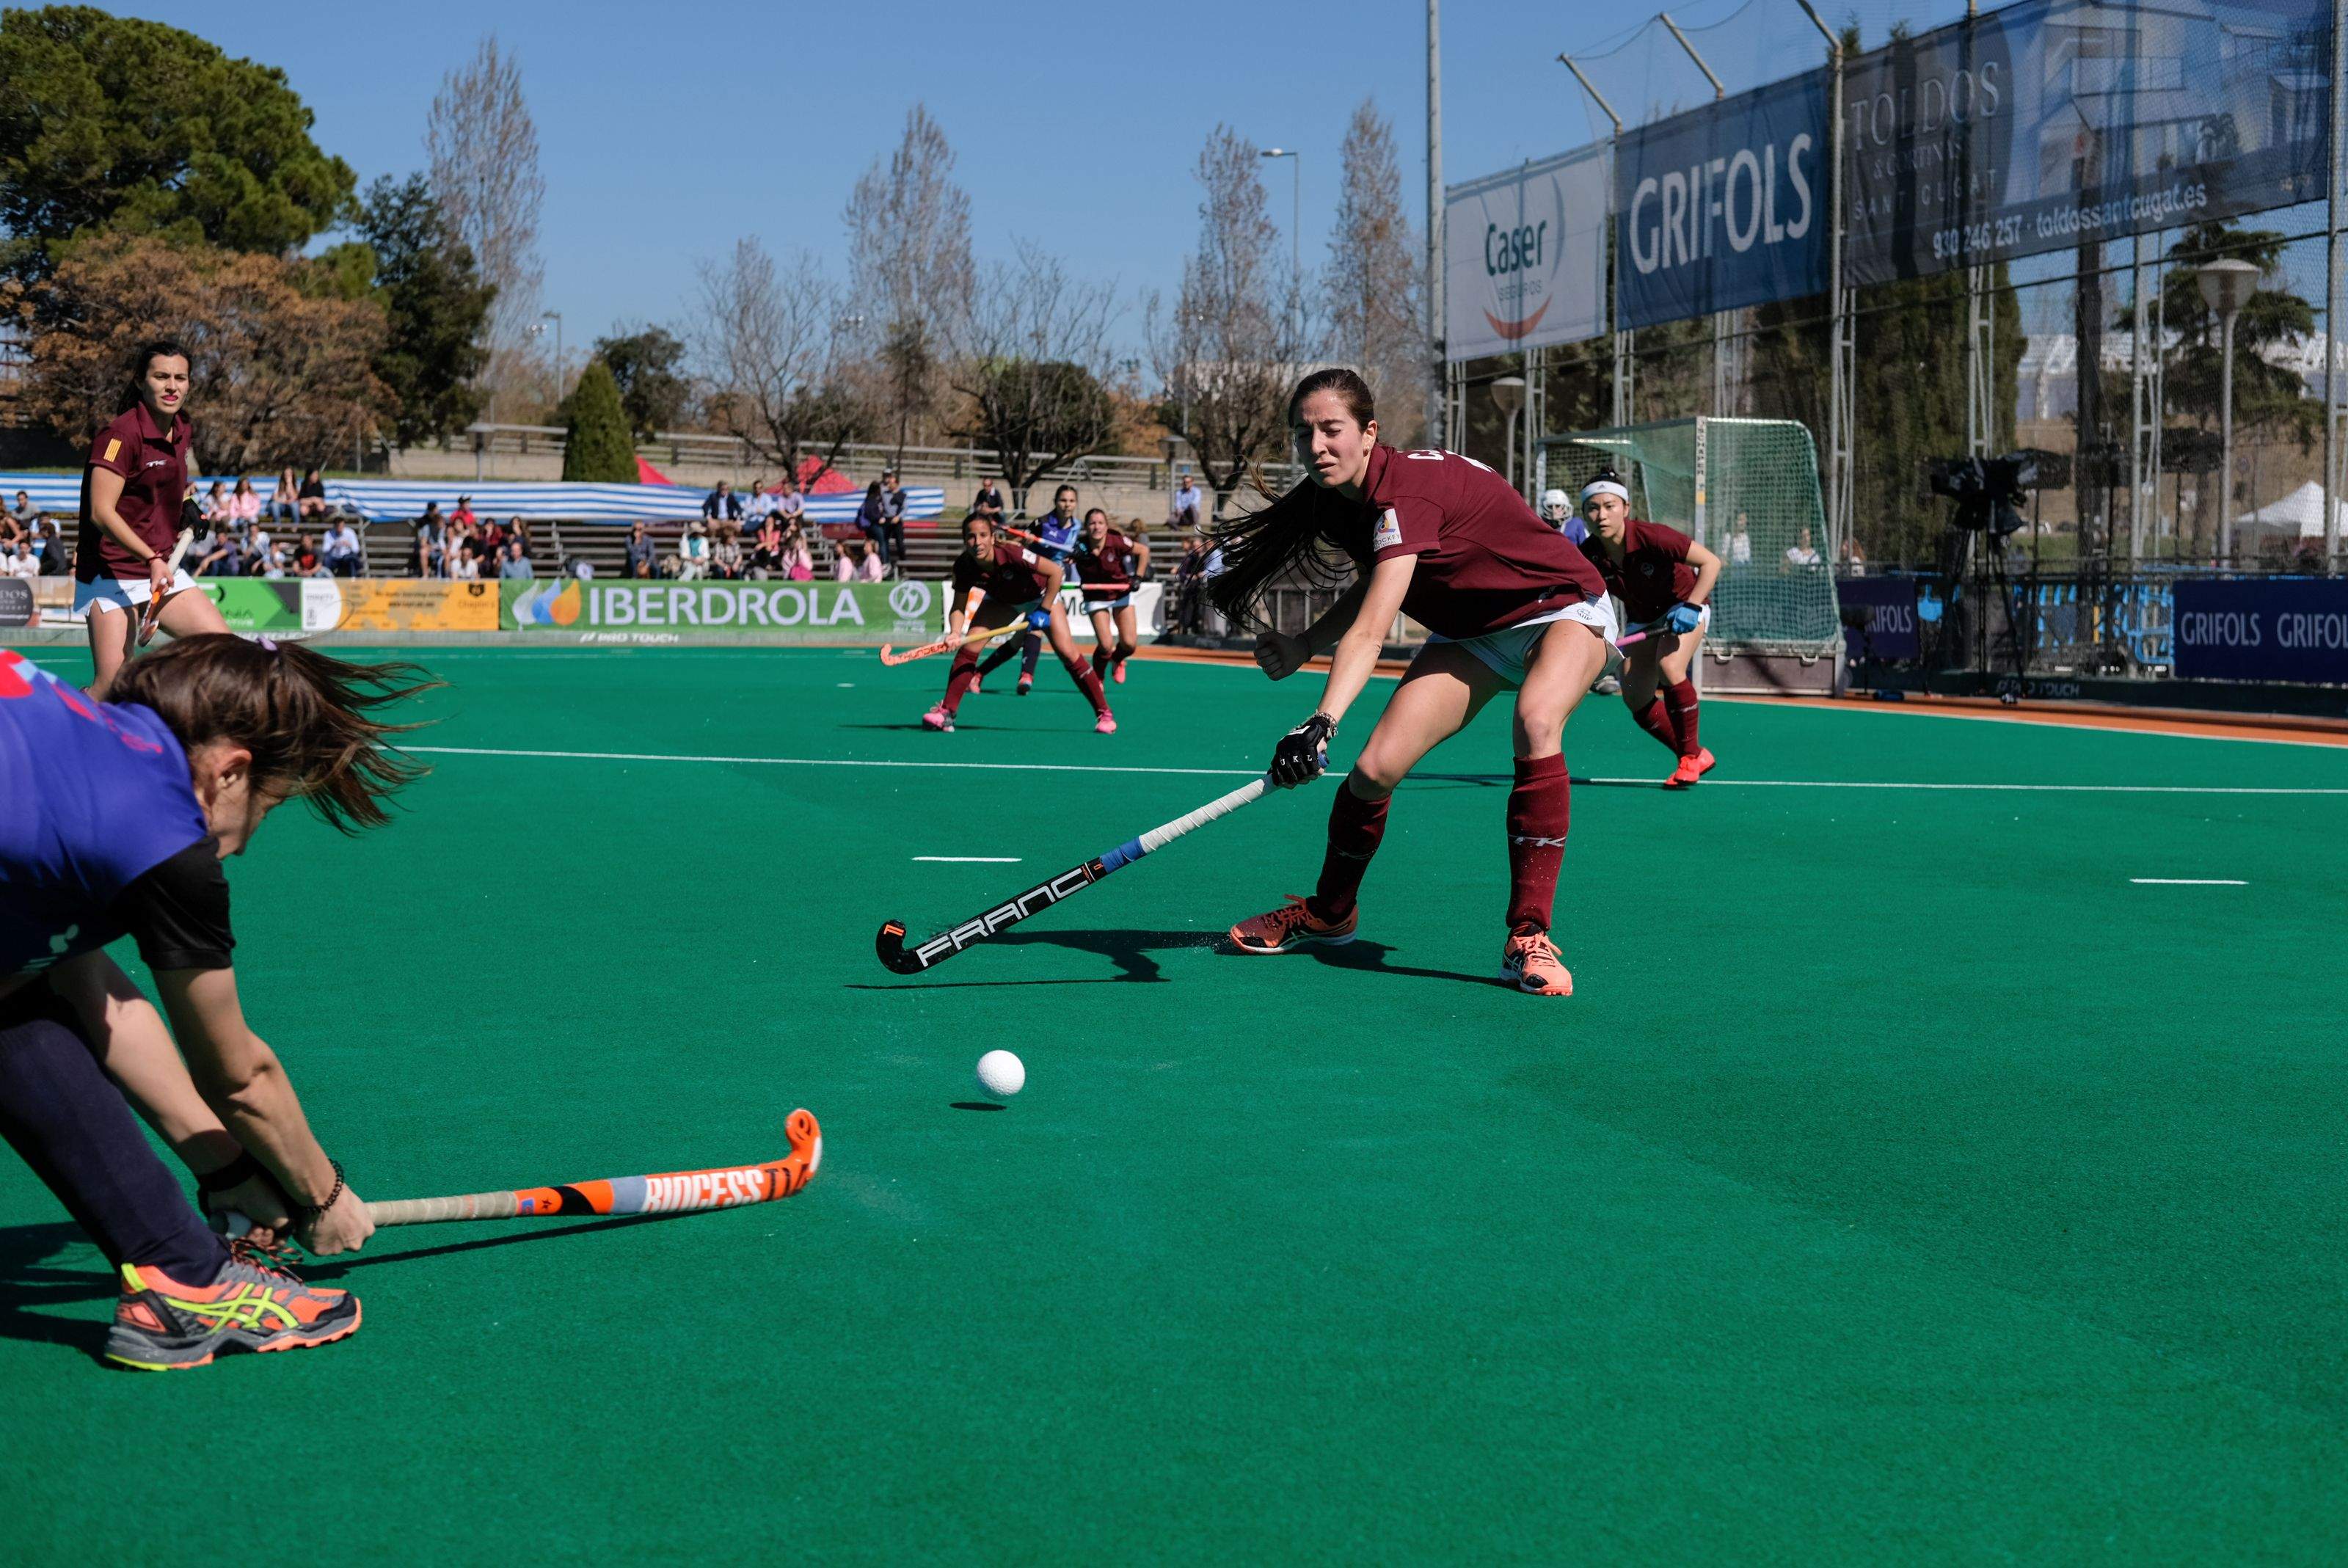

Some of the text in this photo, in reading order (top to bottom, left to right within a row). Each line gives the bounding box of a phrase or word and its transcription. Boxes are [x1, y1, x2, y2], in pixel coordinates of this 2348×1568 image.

[1851, 61, 1999, 150] TOLDOS
[1630, 133, 1812, 274] GRIFOLS
[1921, 168, 1997, 205] CUGAT
[1485, 219, 1547, 277] Caser
[1933, 227, 1959, 260] 930
[1964, 222, 1991, 253] 246
[1995, 214, 2023, 247] 257
[589, 587, 865, 626] IBERDROLA
[1864, 604, 1913, 633] IFOLS
[597, 632, 679, 643] PRO TOUCH
[2181, 611, 2261, 647] GRIFOLS
[916, 867, 1089, 967] FRANC
